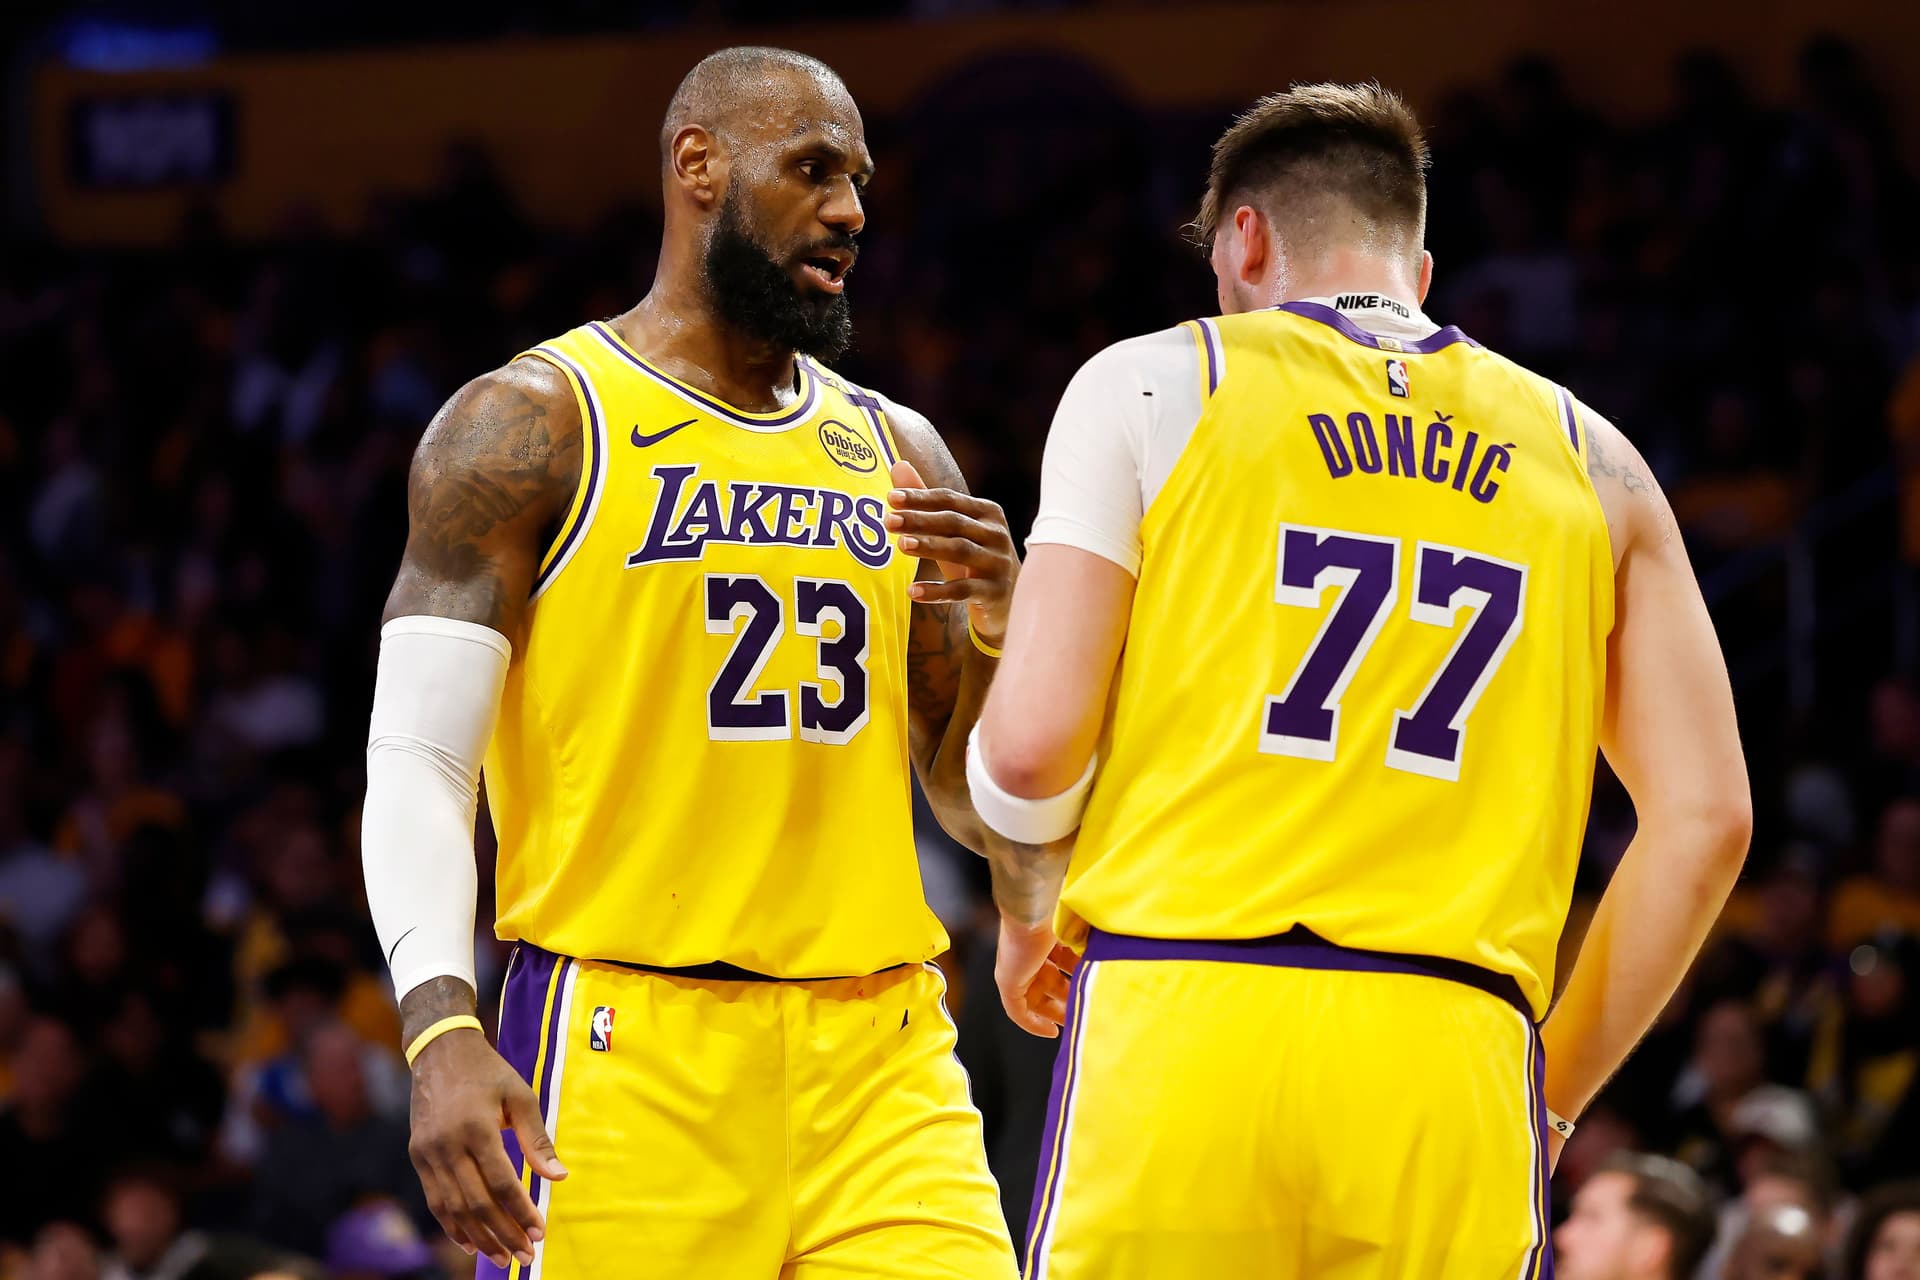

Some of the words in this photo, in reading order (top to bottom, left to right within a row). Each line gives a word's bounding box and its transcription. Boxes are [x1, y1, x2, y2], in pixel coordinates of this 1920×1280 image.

[1335, 296, 1379, 309] NIKE
[1381, 299, 1409, 318] PRO
[823, 429, 873, 461] bibigo
[1307, 410, 1517, 504] DONČIĆ
[625, 464, 892, 569] LAKERS
[704, 572, 870, 746] 23
[1257, 521, 1530, 783] 77
